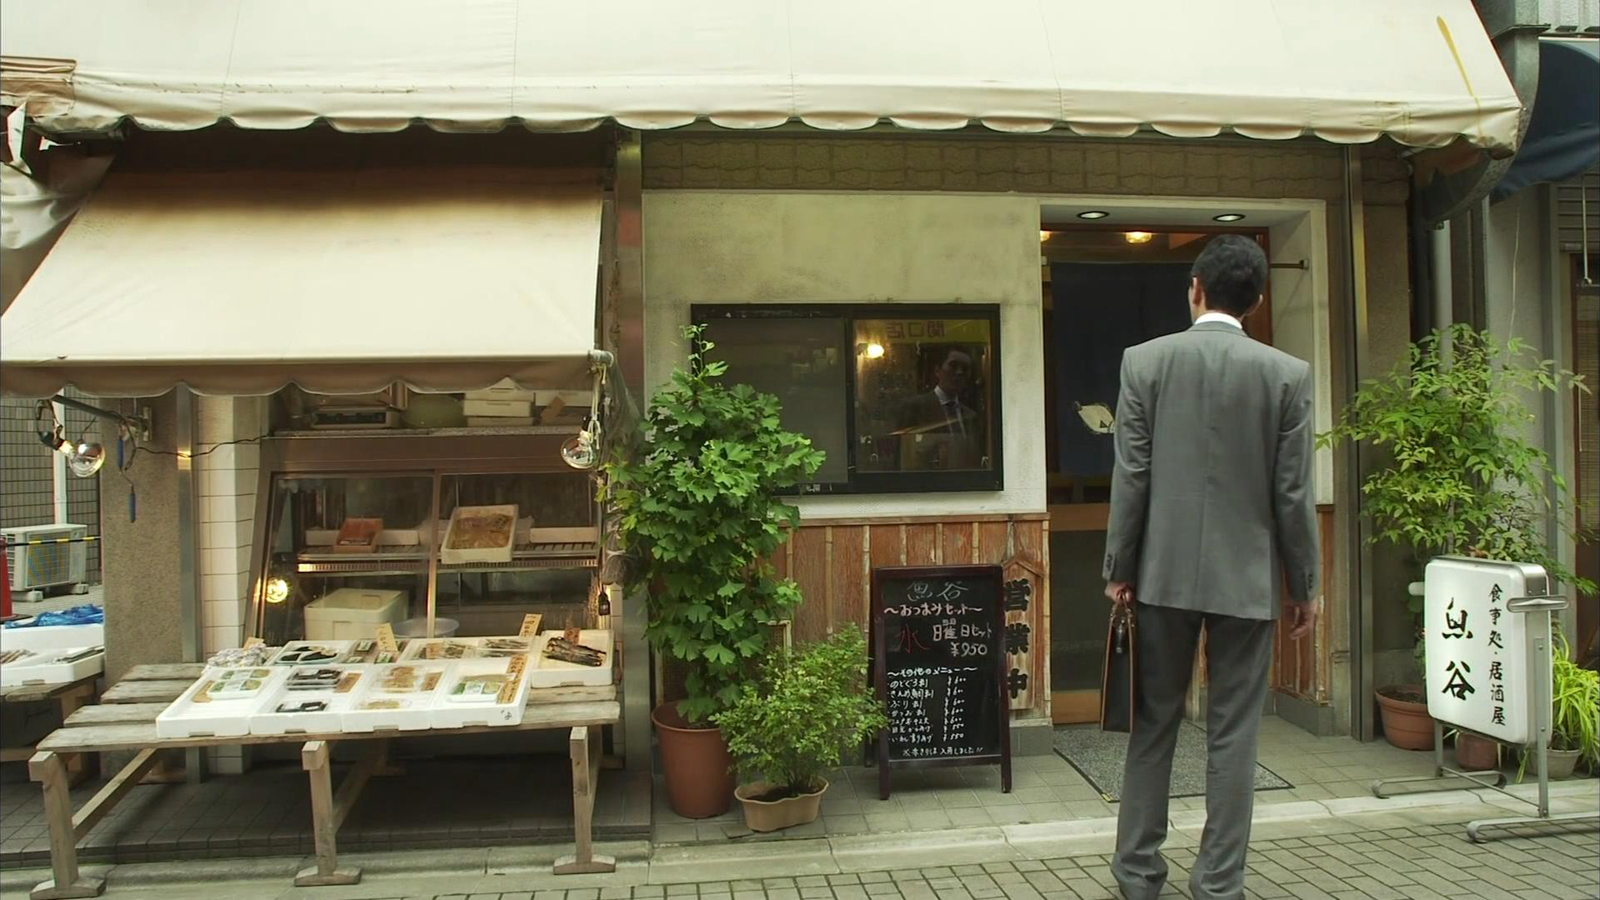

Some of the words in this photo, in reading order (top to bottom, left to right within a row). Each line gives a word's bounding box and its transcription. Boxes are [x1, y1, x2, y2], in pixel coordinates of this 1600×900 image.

[950, 641, 988, 658] ¥950
[1003, 578, 1031, 700] 営業中
[1441, 597, 1476, 701] 魚谷
[1487, 583, 1506, 727] 食事処・居酒屋
